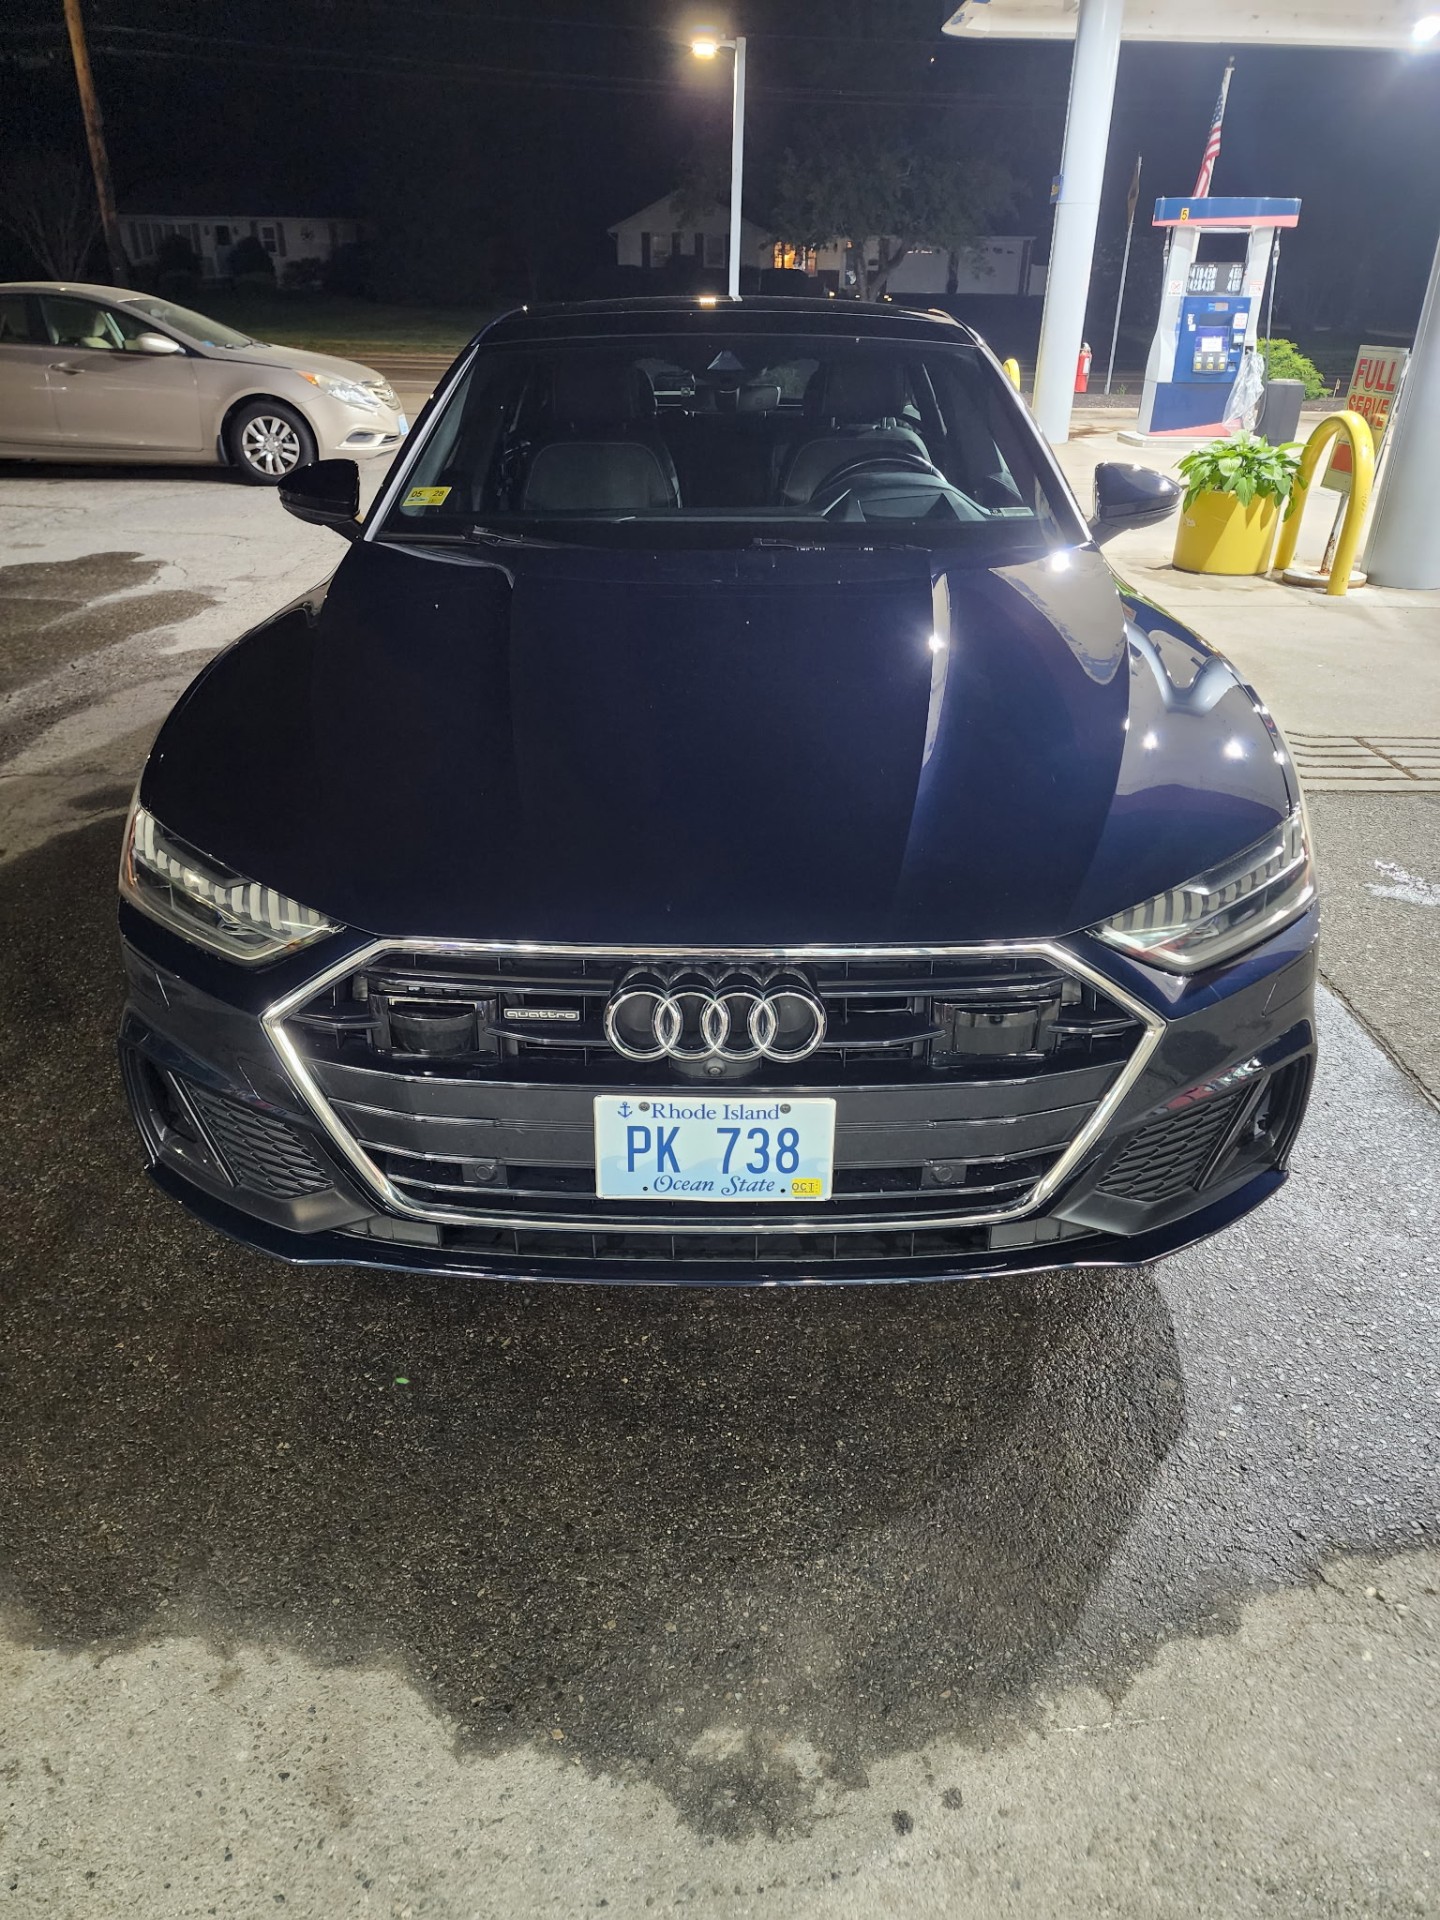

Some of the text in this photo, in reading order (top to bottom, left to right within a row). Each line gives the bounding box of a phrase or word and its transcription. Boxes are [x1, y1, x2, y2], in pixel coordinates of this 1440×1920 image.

[1181, 209, 1188, 221] 5
[1353, 357, 1397, 393] FULL
[411, 490, 424, 498] 05
[506, 1010, 577, 1019] quattro
[650, 1102, 780, 1121] Rhode Island
[626, 1125, 800, 1175] PK 738
[653, 1174, 775, 1197] Ocean State
[791, 1182, 815, 1191] OCT
